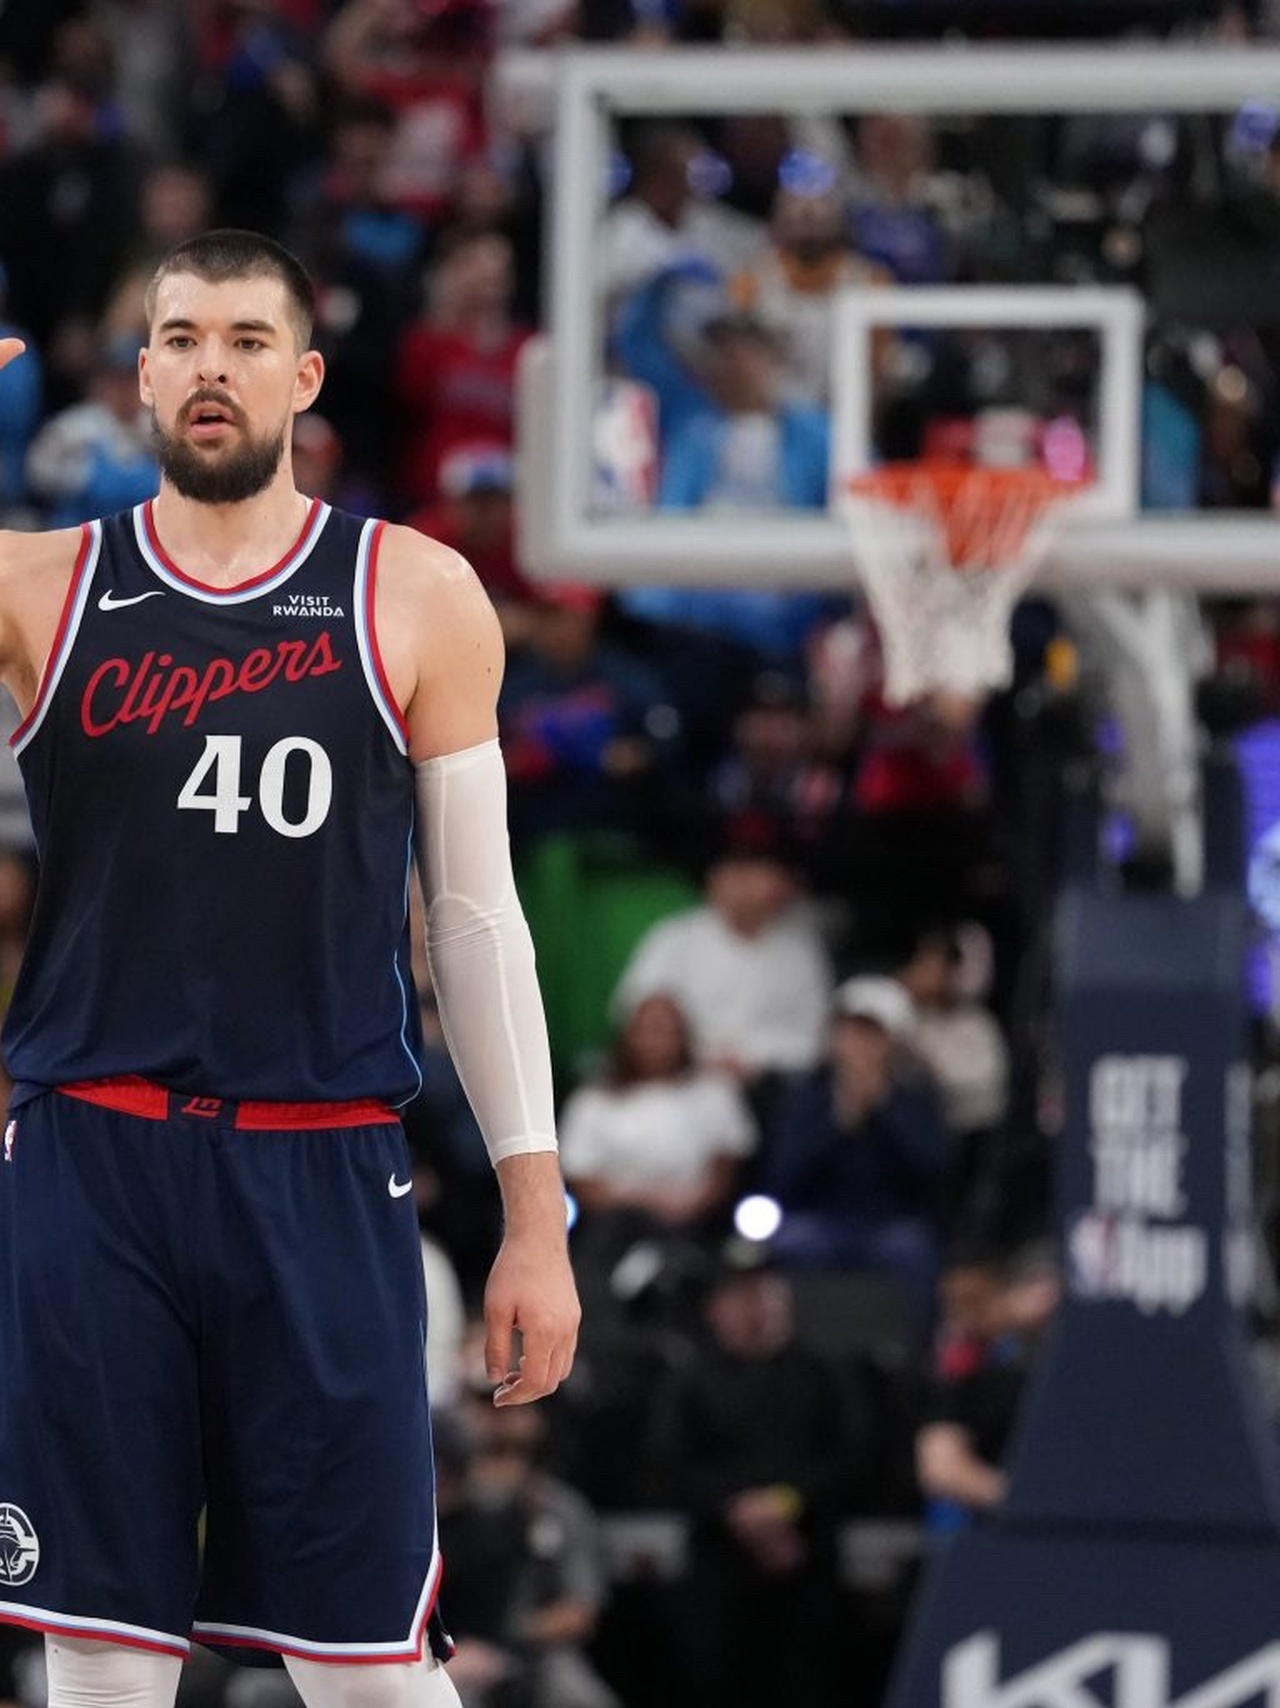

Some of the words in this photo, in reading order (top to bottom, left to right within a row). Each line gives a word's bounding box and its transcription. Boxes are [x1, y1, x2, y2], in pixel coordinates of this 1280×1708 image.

[272, 605, 345, 617] RWANDA
[288, 595, 330, 606] VISIT
[81, 631, 342, 737] Clippers
[177, 735, 333, 838] 40
